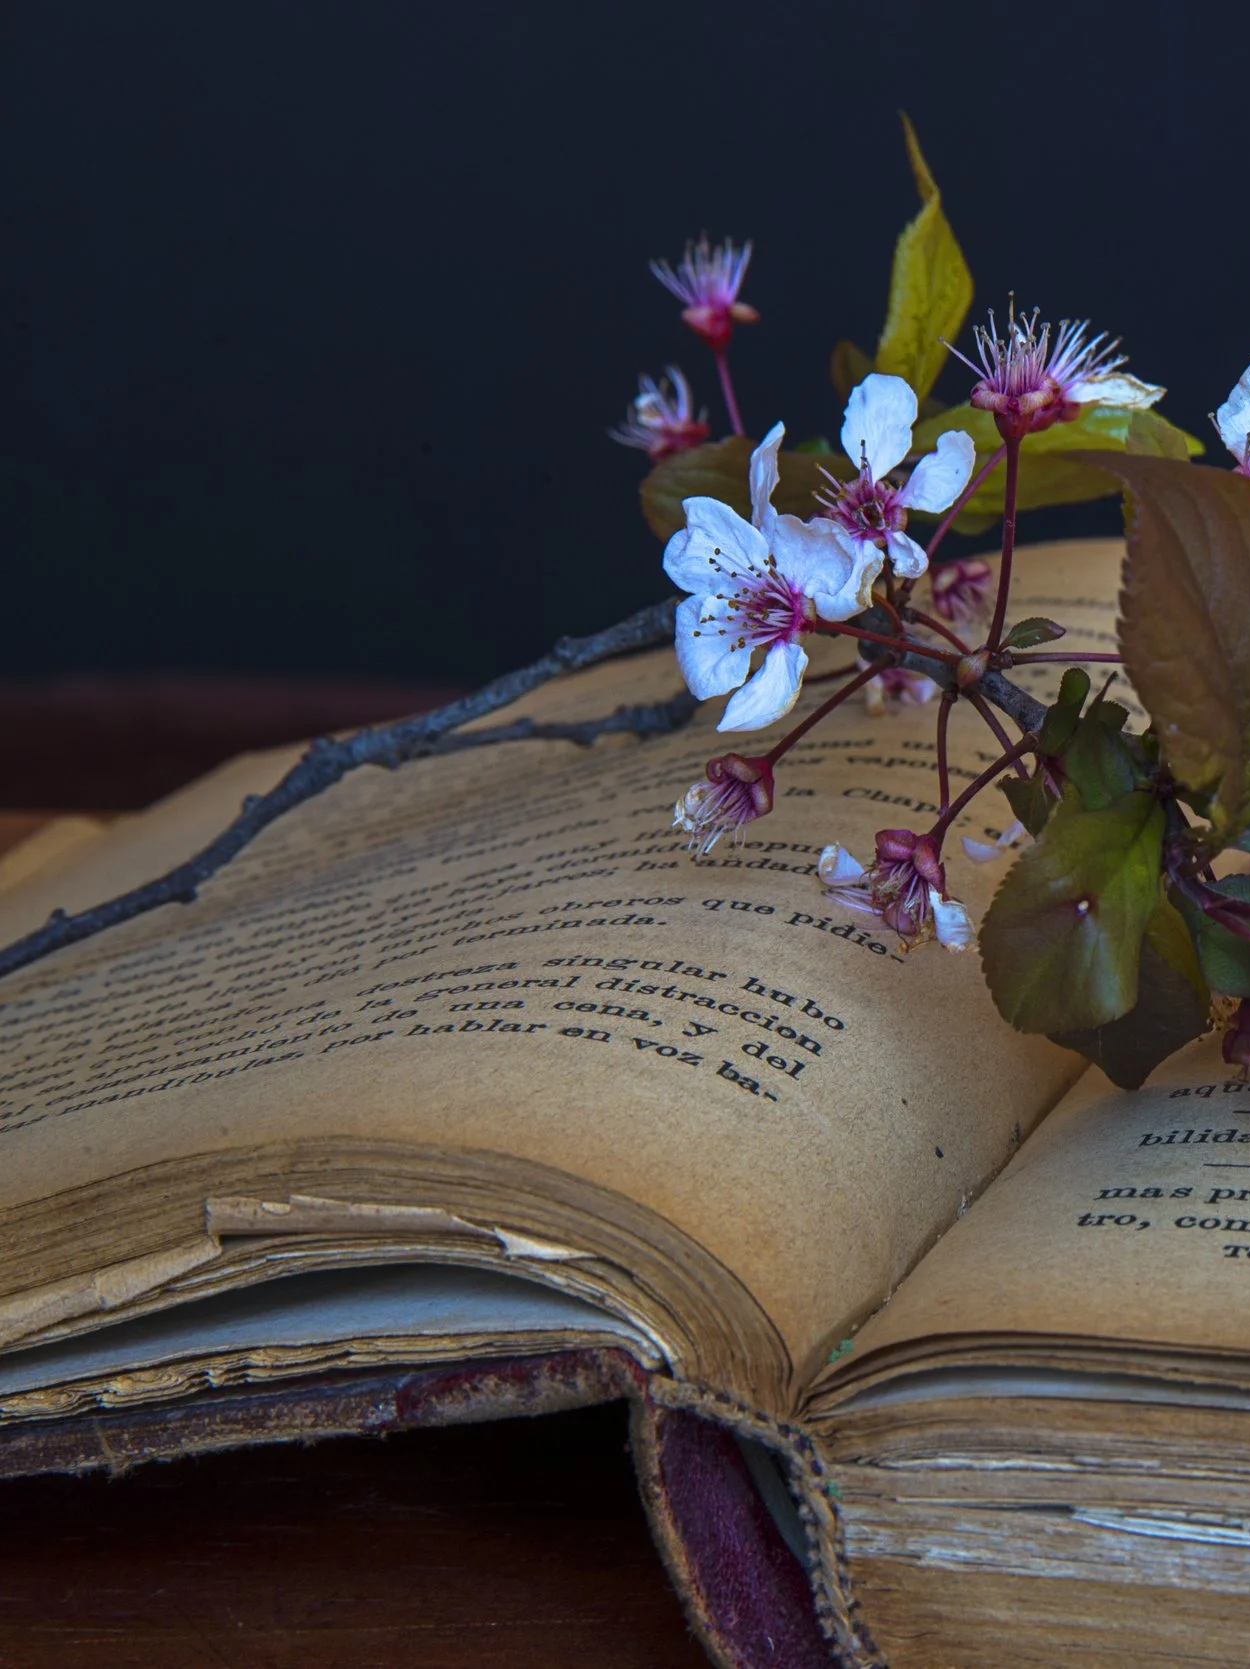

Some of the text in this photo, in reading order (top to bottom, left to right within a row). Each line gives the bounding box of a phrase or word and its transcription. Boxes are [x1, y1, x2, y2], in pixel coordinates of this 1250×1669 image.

[697, 857, 822, 878] andad
[452, 914, 667, 946] terminada.
[539, 897, 686, 915] obreros
[702, 899, 775, 915] que
[784, 912, 904, 964] pidie-
[356, 962, 520, 997] destreza
[542, 955, 727, 981] singular
[739, 977, 844, 1030] hubo
[413, 976, 581, 1002] general
[595, 977, 822, 1056] distraccion
[318, 1030, 394, 1054] por
[404, 1019, 547, 1036] hablar
[557, 1027, 611, 1043] en
[629, 1037, 704, 1067] voz
[716, 1064, 779, 1102] ba-
[449, 1000, 524, 1012] una
[551, 1000, 663, 1027] cena,
[682, 1020, 720, 1037] y
[741, 1044, 806, 1079] del
[1077, 1212, 1150, 1231] tro,
[1095, 1187, 1193, 1201] mas
